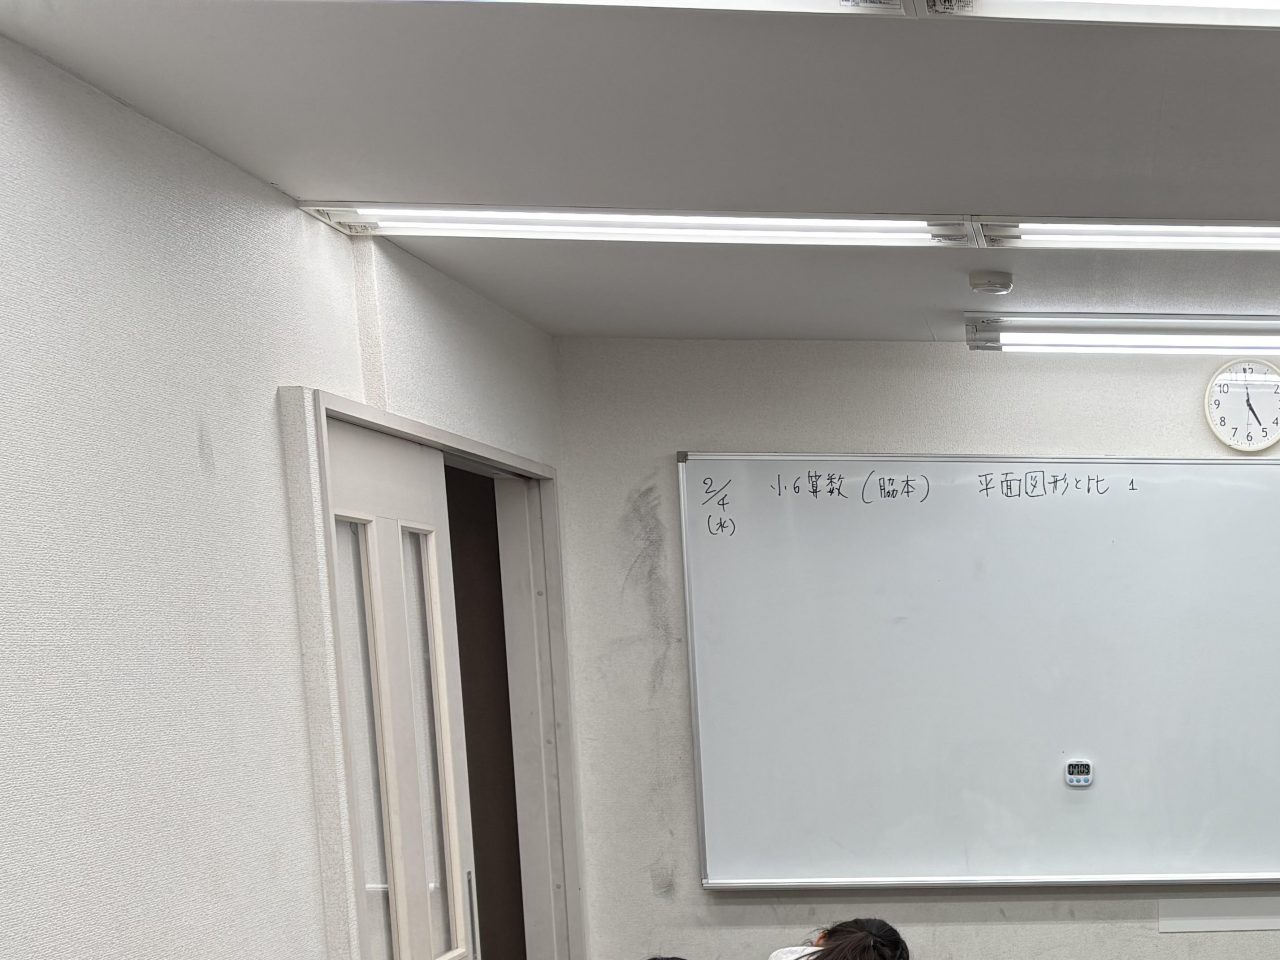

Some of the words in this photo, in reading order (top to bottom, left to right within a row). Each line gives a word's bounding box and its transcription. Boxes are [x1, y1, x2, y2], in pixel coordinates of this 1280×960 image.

[1219, 384, 1229, 394] 10
[1273, 384, 1280, 394] 2
[1213, 399, 1221, 409] 9
[1219, 416, 1226, 426] 8
[1272, 417, 1279, 426] 4
[1231, 427, 1238, 437] 7
[1246, 432, 1253, 442] 6
[1261, 428, 1268, 438] 5
[702, 477, 731, 512] 2/4
[708, 515, 736, 536] (水)
